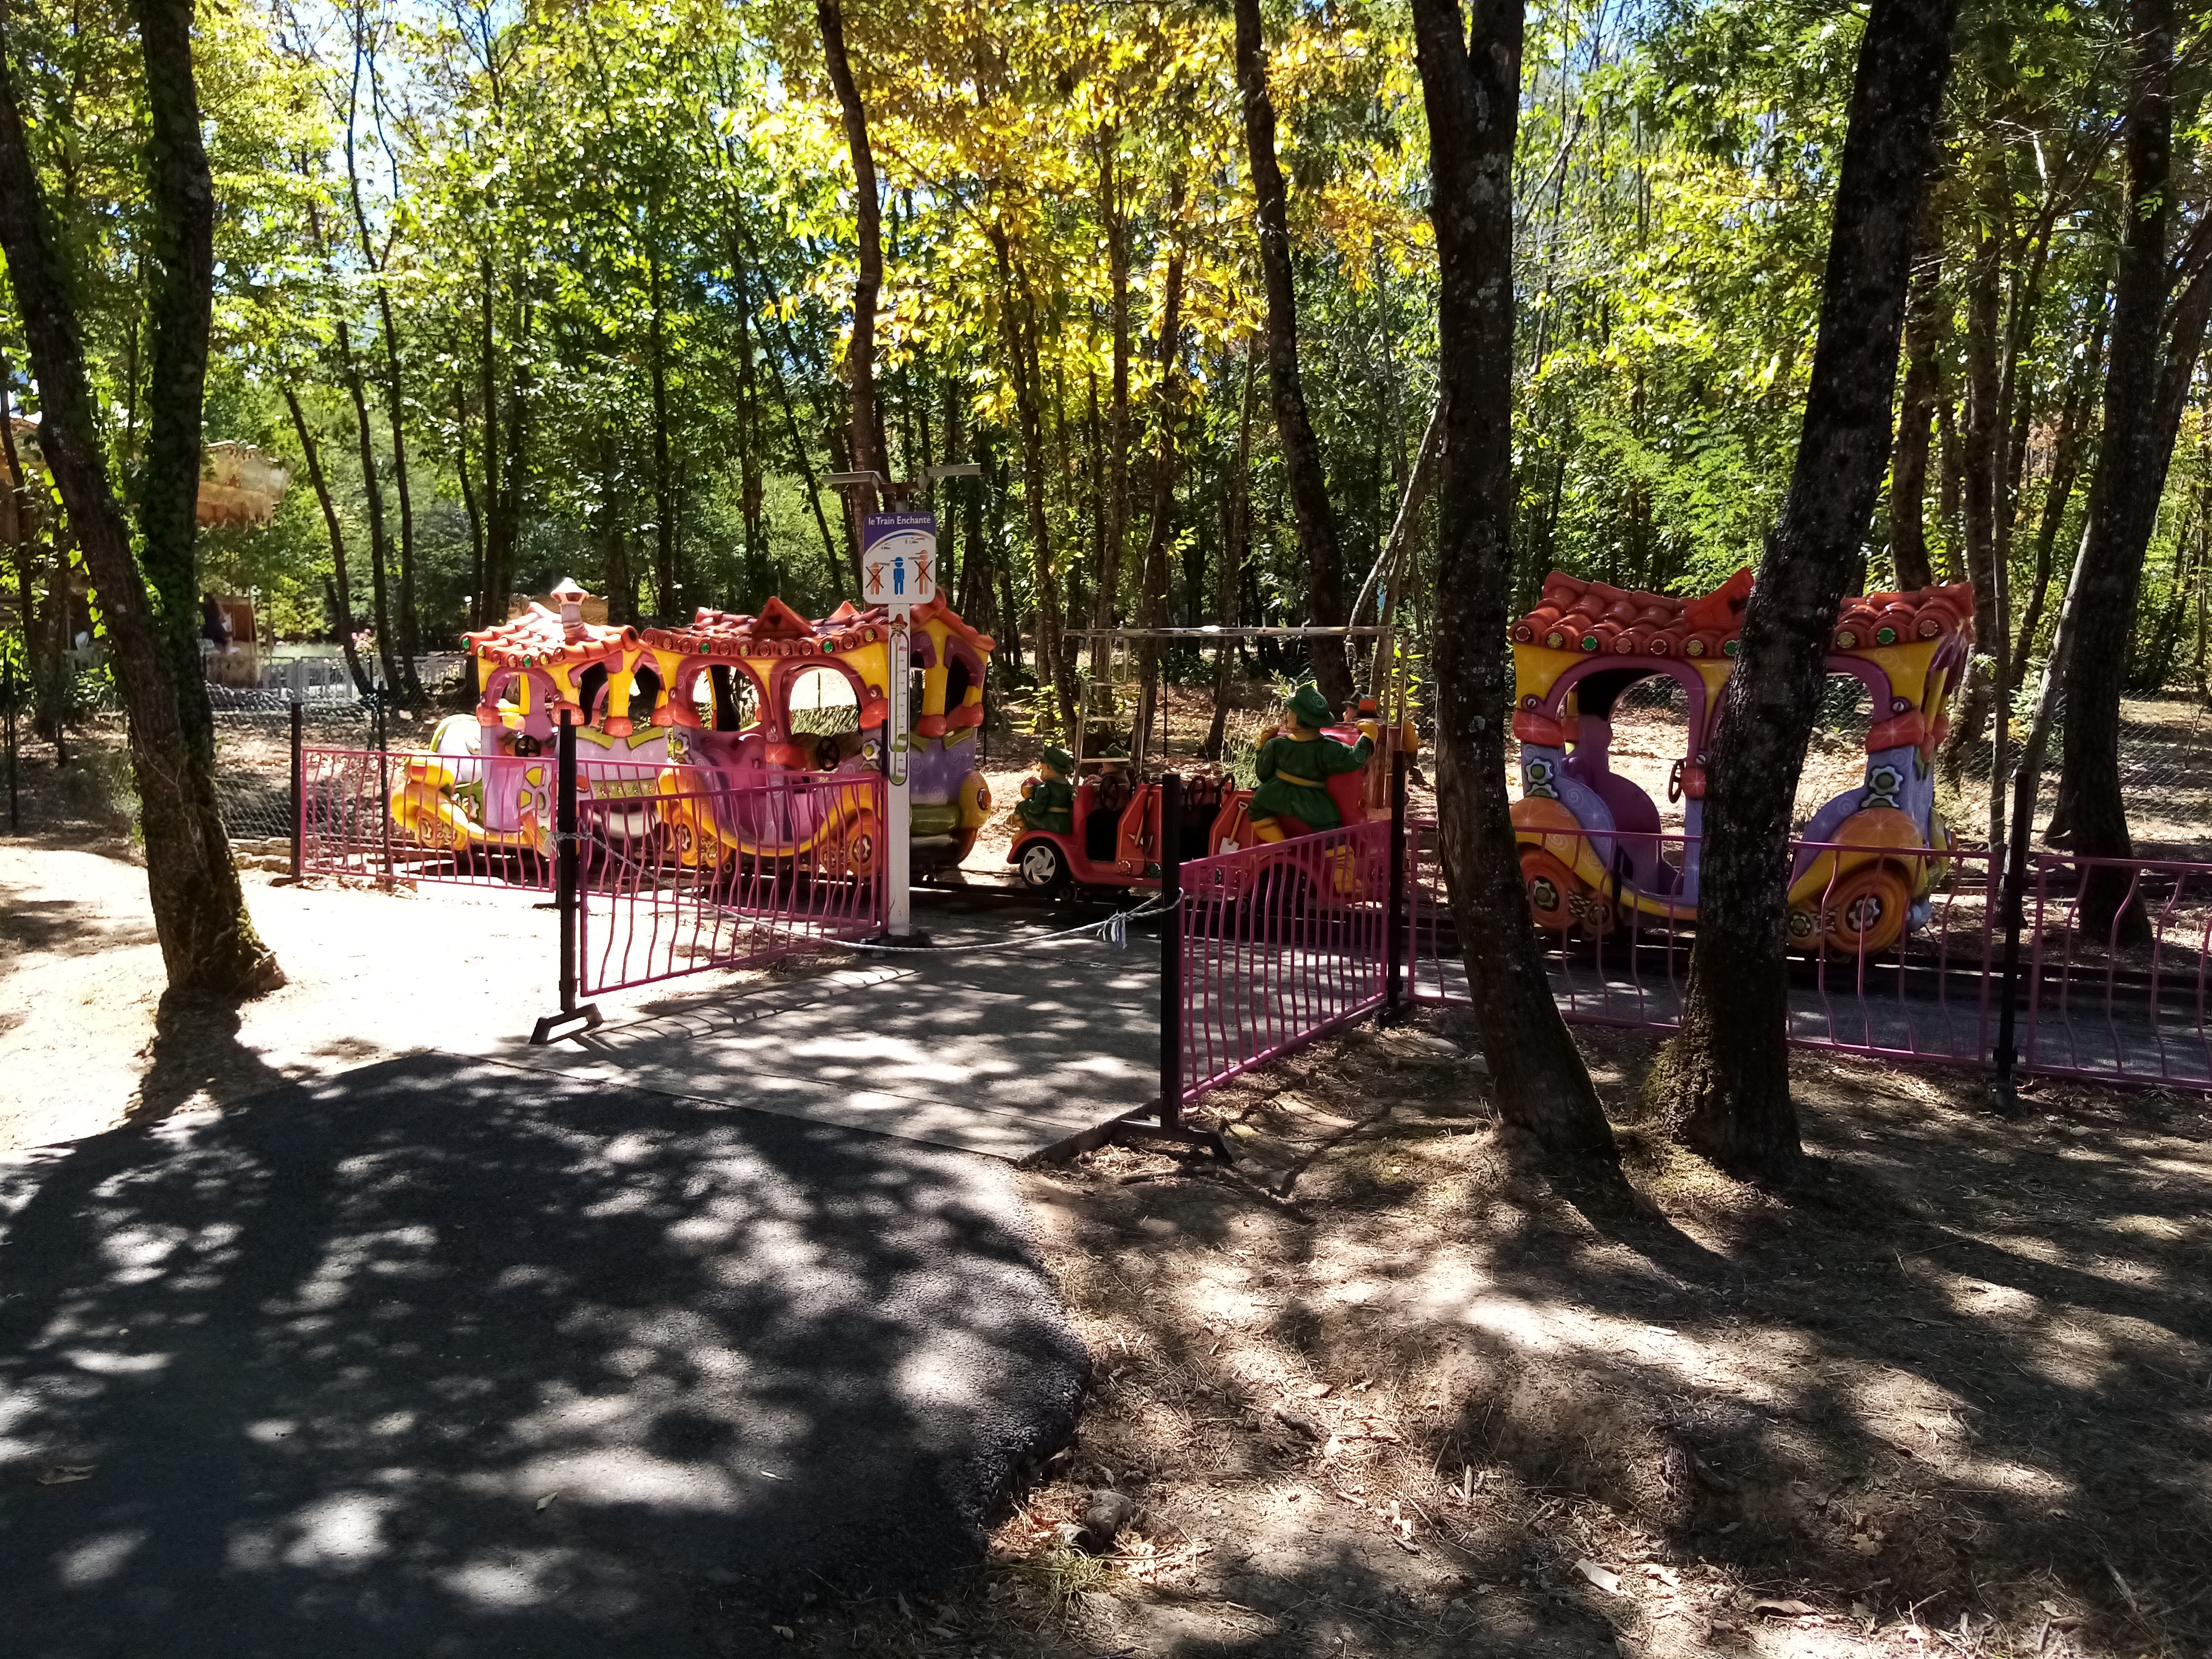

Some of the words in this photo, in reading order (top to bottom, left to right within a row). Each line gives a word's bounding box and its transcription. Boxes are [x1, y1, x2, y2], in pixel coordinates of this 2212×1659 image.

[868, 517, 875, 525] le
[876, 516, 894, 525] Train
[896, 515, 931, 525] Enchanté
